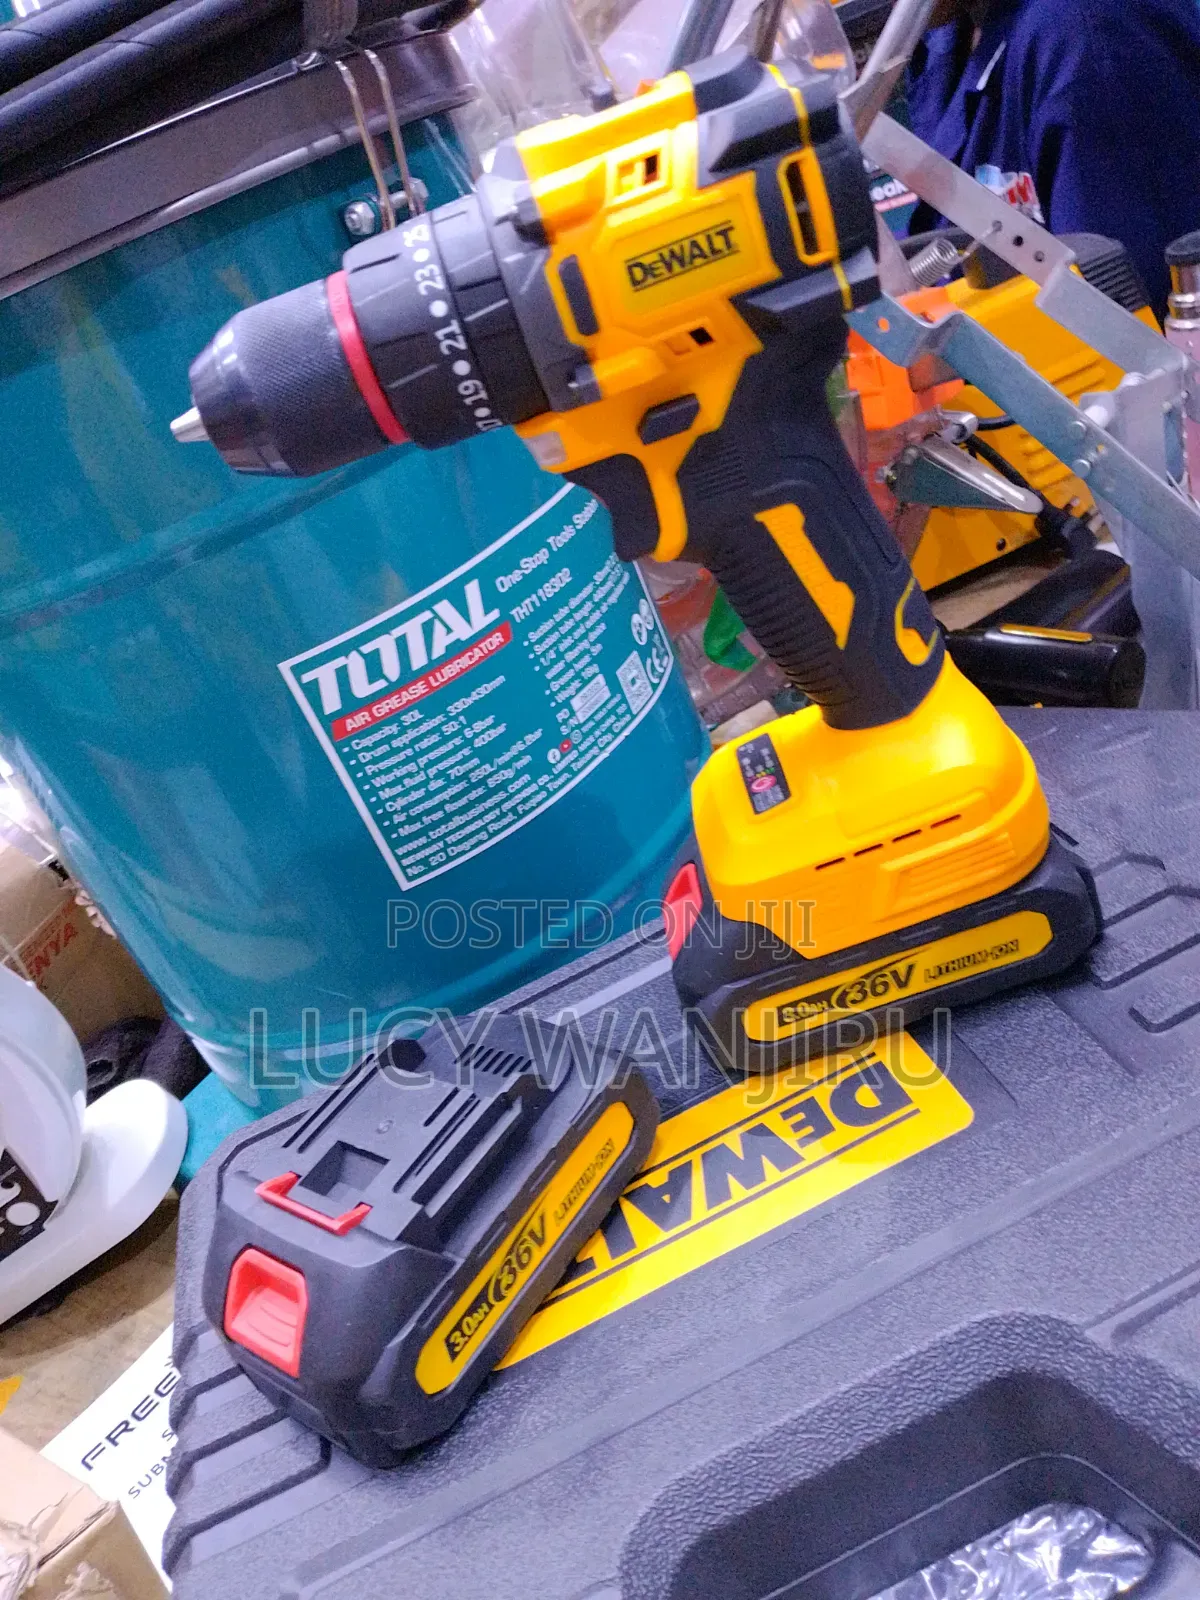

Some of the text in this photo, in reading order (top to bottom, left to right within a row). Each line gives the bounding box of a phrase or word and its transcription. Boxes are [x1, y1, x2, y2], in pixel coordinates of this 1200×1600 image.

[414, 263, 445, 295] 23
[434, 319, 468, 355] 21
[457, 379, 489, 406] 19
[495, 548, 550, 593] One-Stop
[546, 525, 576, 551] Tools
[509, 567, 573, 623] THT118302
[301, 578, 500, 716] TOTAL
[345, 631, 504, 732] AIR GREASE LUBRICATOR
[351, 723, 400, 750] Capacity:
[357, 744, 391, 763] Drum
[364, 748, 415, 776] Pressure
[370, 762, 419, 788] Working
[416, 736, 465, 769] pressure:
[426, 746, 473, 779] pressure:
[384, 787, 426, 813] Cylinder
[428, 851, 447, 867] 20
